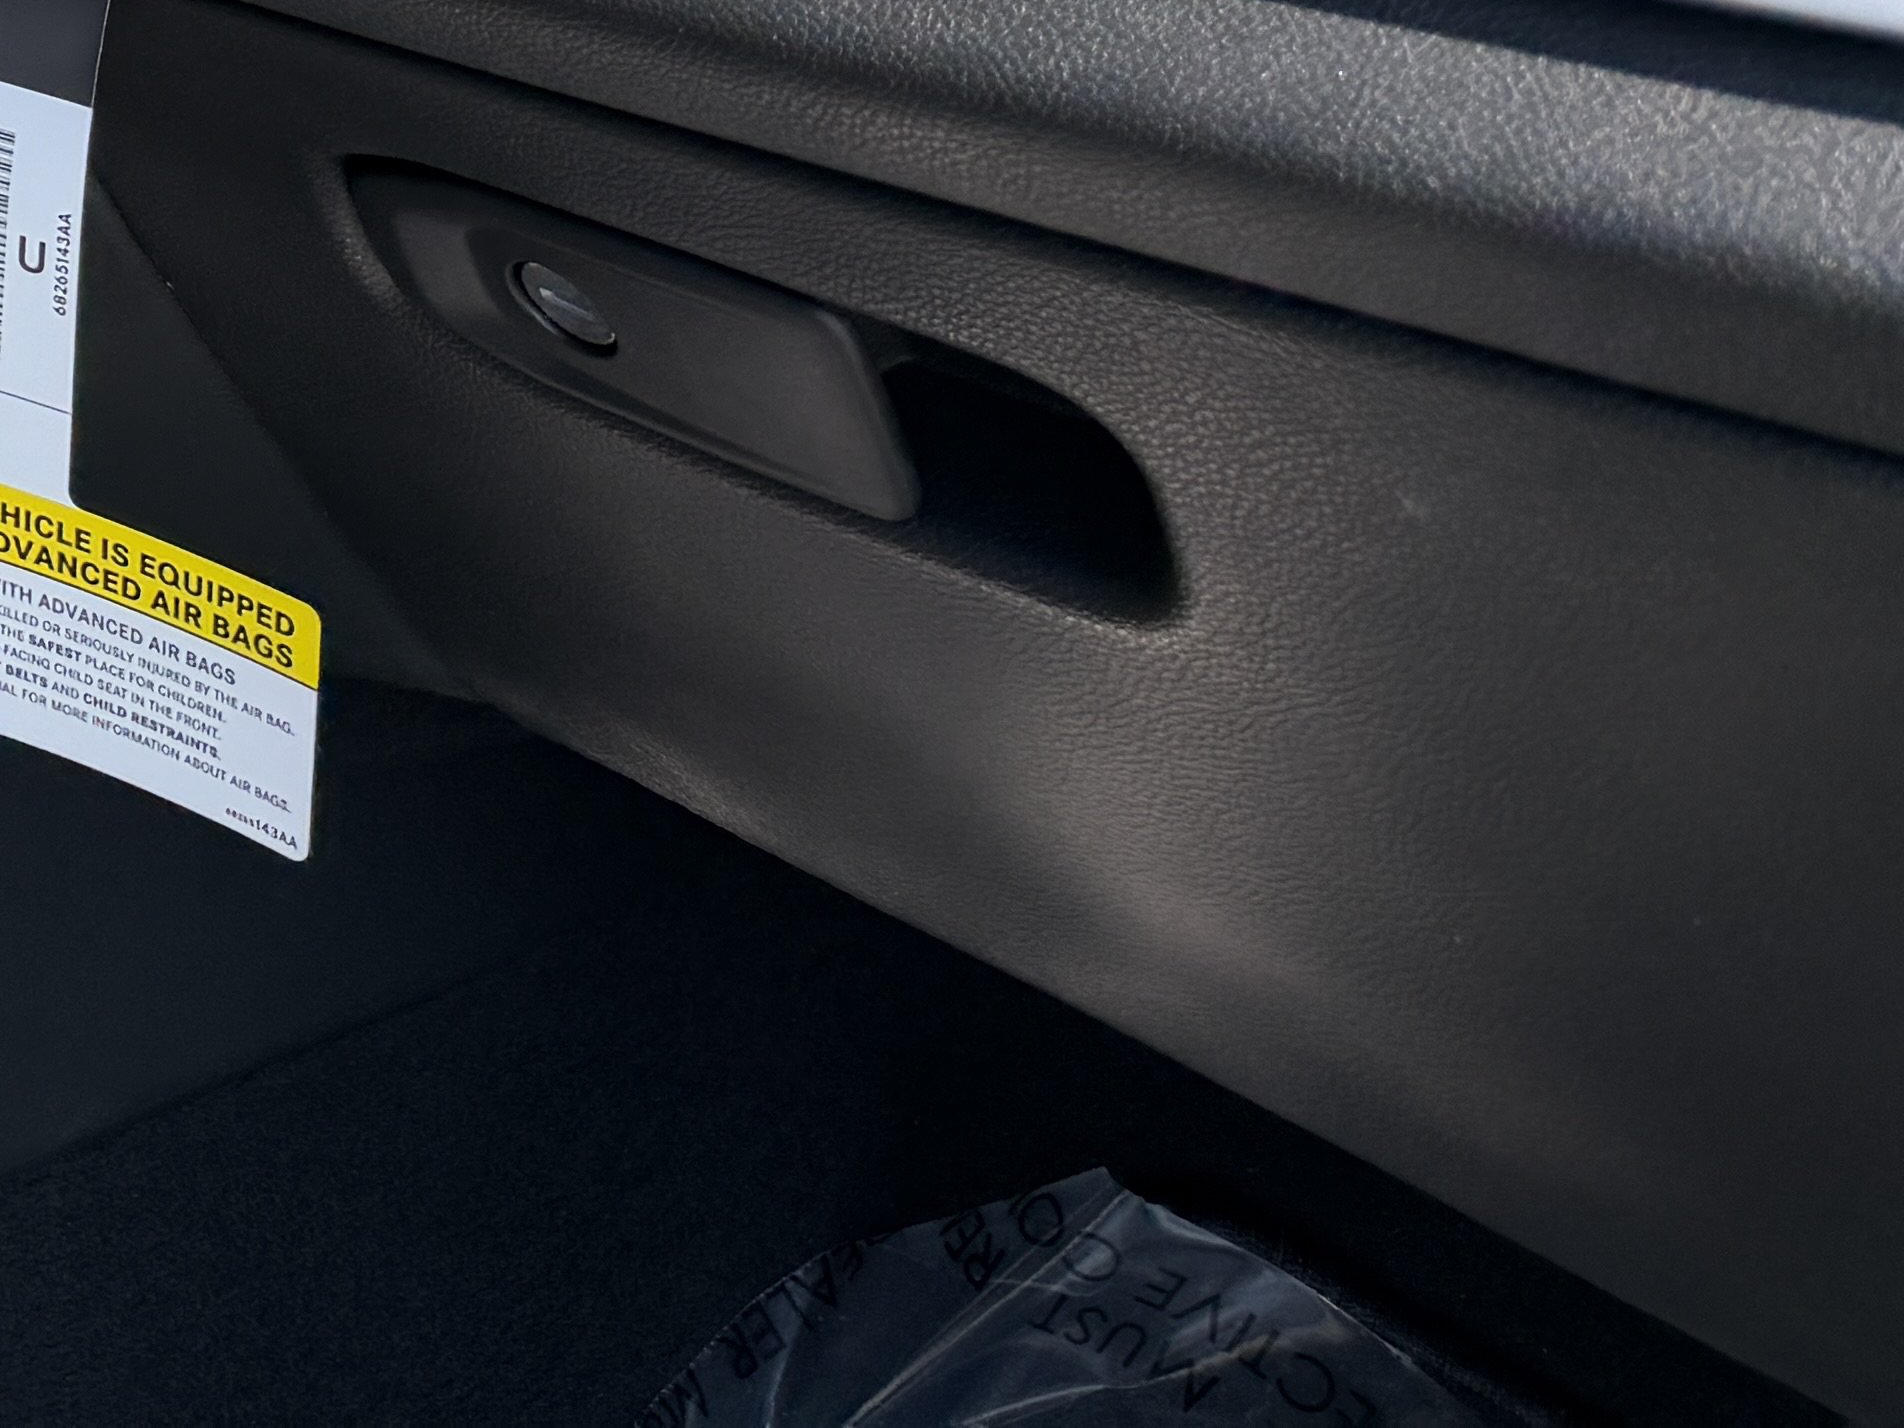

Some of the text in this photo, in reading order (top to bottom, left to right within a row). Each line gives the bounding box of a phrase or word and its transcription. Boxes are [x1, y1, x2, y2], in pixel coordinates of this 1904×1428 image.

[18, 235, 46, 274] U
[52, 213, 72, 317] 68265143AA
[101, 537, 129, 567] IS
[140, 552, 295, 637] EQUIPPED
[151, 590, 202, 630] AIR
[212, 613, 293, 668] BAGS
[0, 623, 24, 642] THE
[28, 634, 82, 662] SAFEST
[85, 654, 125, 681] PLACE
[129, 671, 154, 692] FOR
[157, 684, 227, 723] CHILDREN.
[38, 594, 143, 645] ADVANCED
[148, 636, 180, 662] AIR
[186, 651, 236, 685] BAGS
[42, 620, 61, 637] OR
[64, 628, 135, 664] SERIOUSLY
[137, 657, 191, 687] INJURED
[194, 680, 210, 696] BY
[213, 689, 238, 710] THE
[241, 702, 262, 722] AIR
[266, 713, 295, 736] BAG.
[1031, 1294, 1221, 1414] MUST
